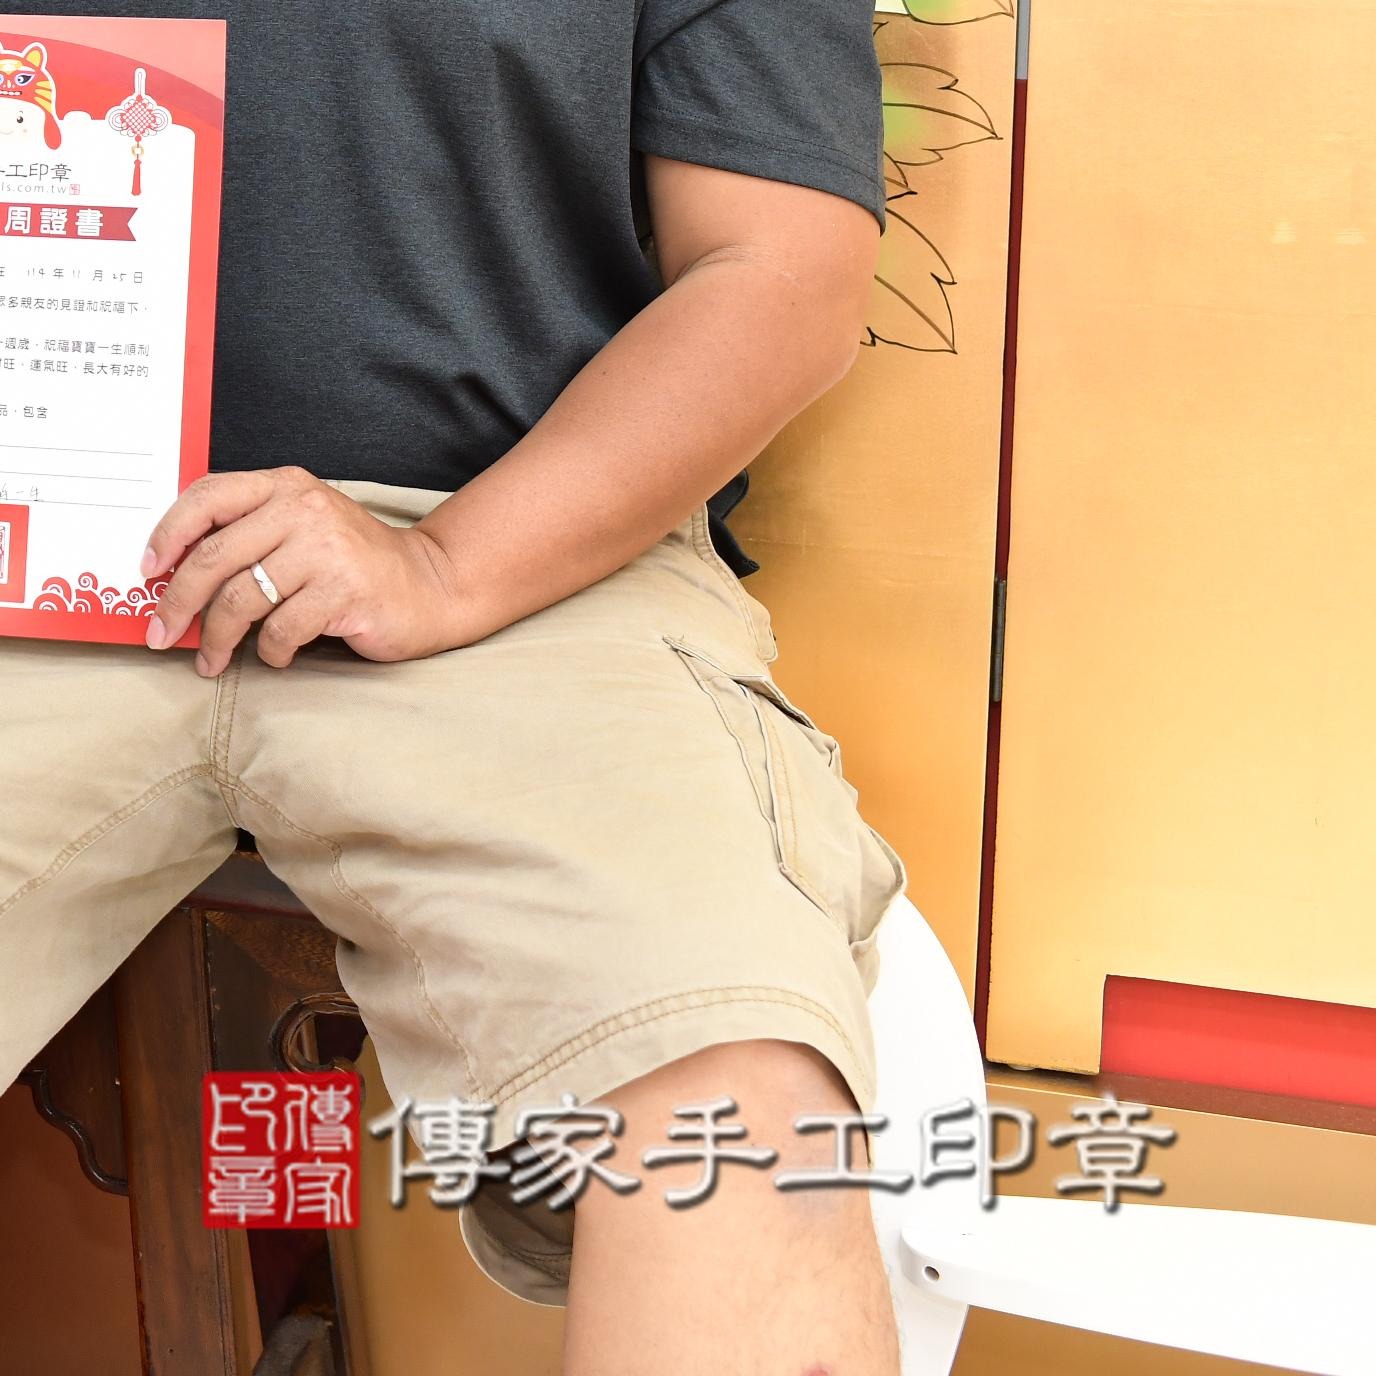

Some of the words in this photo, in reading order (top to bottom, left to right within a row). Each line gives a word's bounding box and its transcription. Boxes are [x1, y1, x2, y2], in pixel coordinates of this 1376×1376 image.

[52, 267, 64, 280] 年
[92, 269, 104, 283] 月
[133, 271, 143, 284] 日
